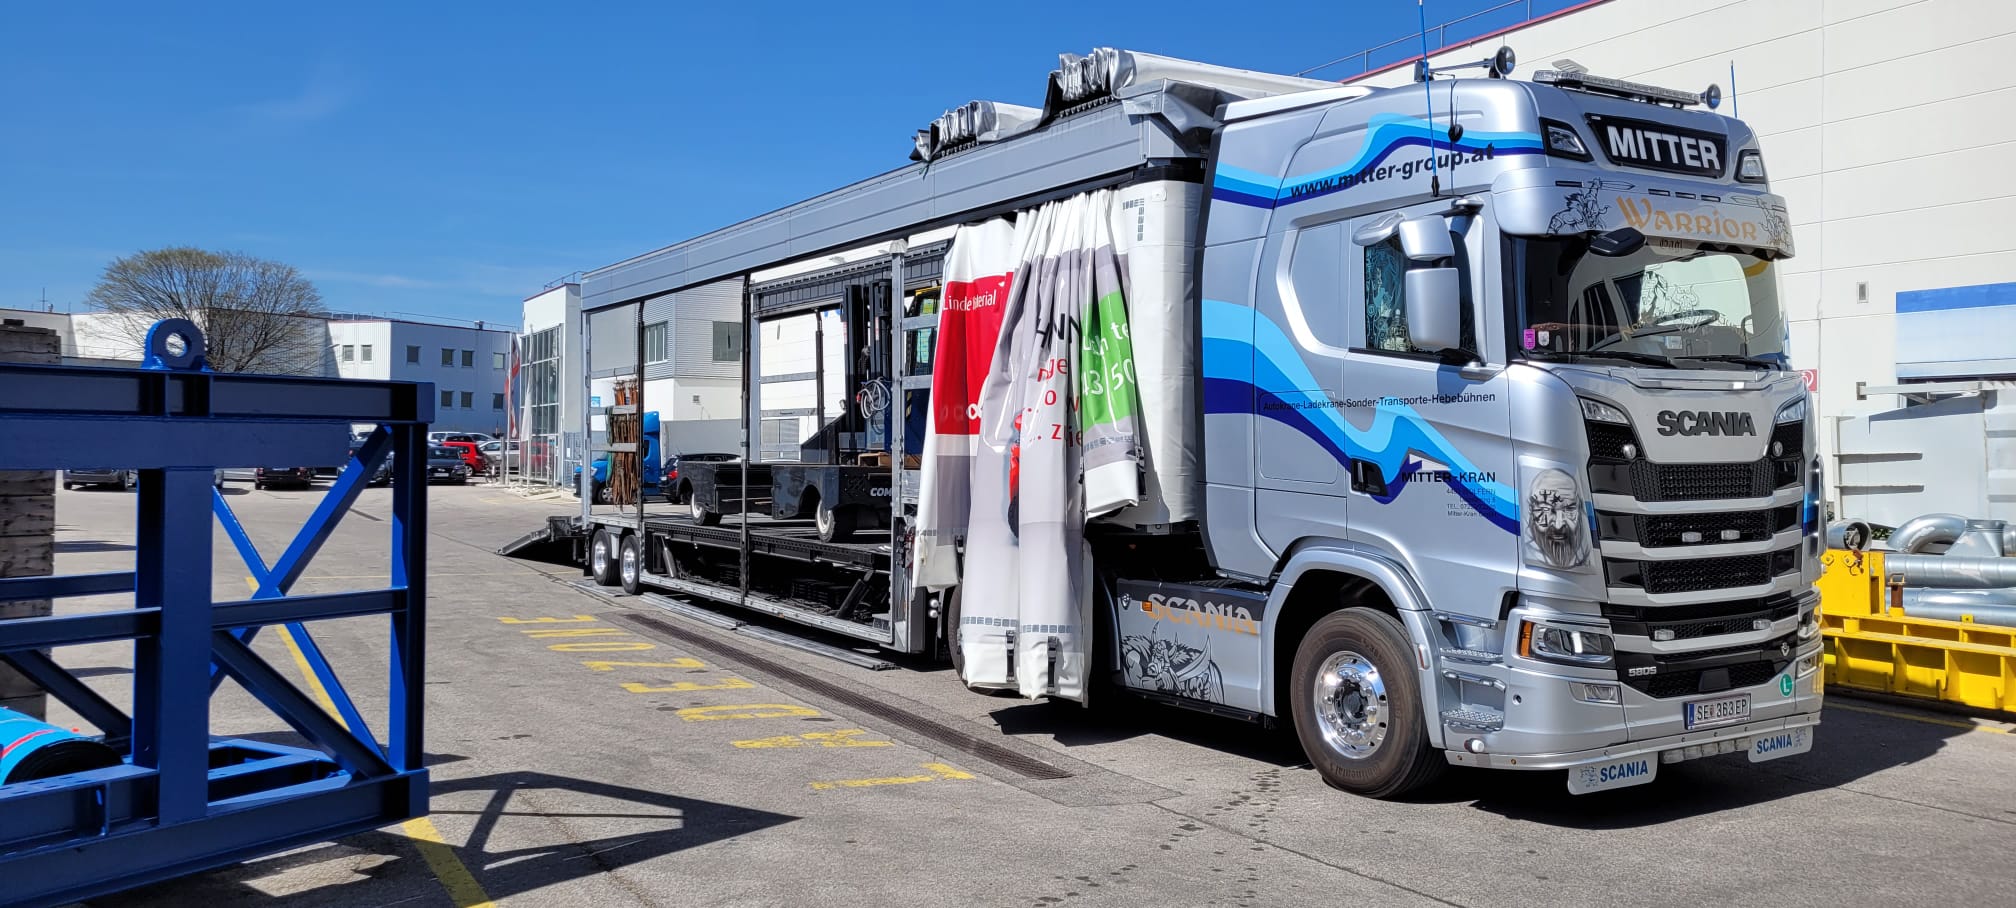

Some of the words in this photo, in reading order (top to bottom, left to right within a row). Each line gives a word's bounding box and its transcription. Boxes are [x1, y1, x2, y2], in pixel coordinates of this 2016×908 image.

[1606, 125, 1721, 170] MITTER
[1290, 142, 1495, 198] www.mitter-group.at
[1656, 409, 1757, 437] SCANIA
[1401, 471, 1496, 483] MITTER-KRAN
[1146, 593, 1257, 635] SCANIA
[1628, 666, 1657, 677] 580S
[1782, 677, 1791, 693] L
[1697, 705, 1709, 721] SE
[1716, 701, 1734, 718] 363
[1735, 698, 1747, 715] EP
[1755, 733, 1793, 755] SCANIA
[1600, 759, 1649, 783] SCANIA
